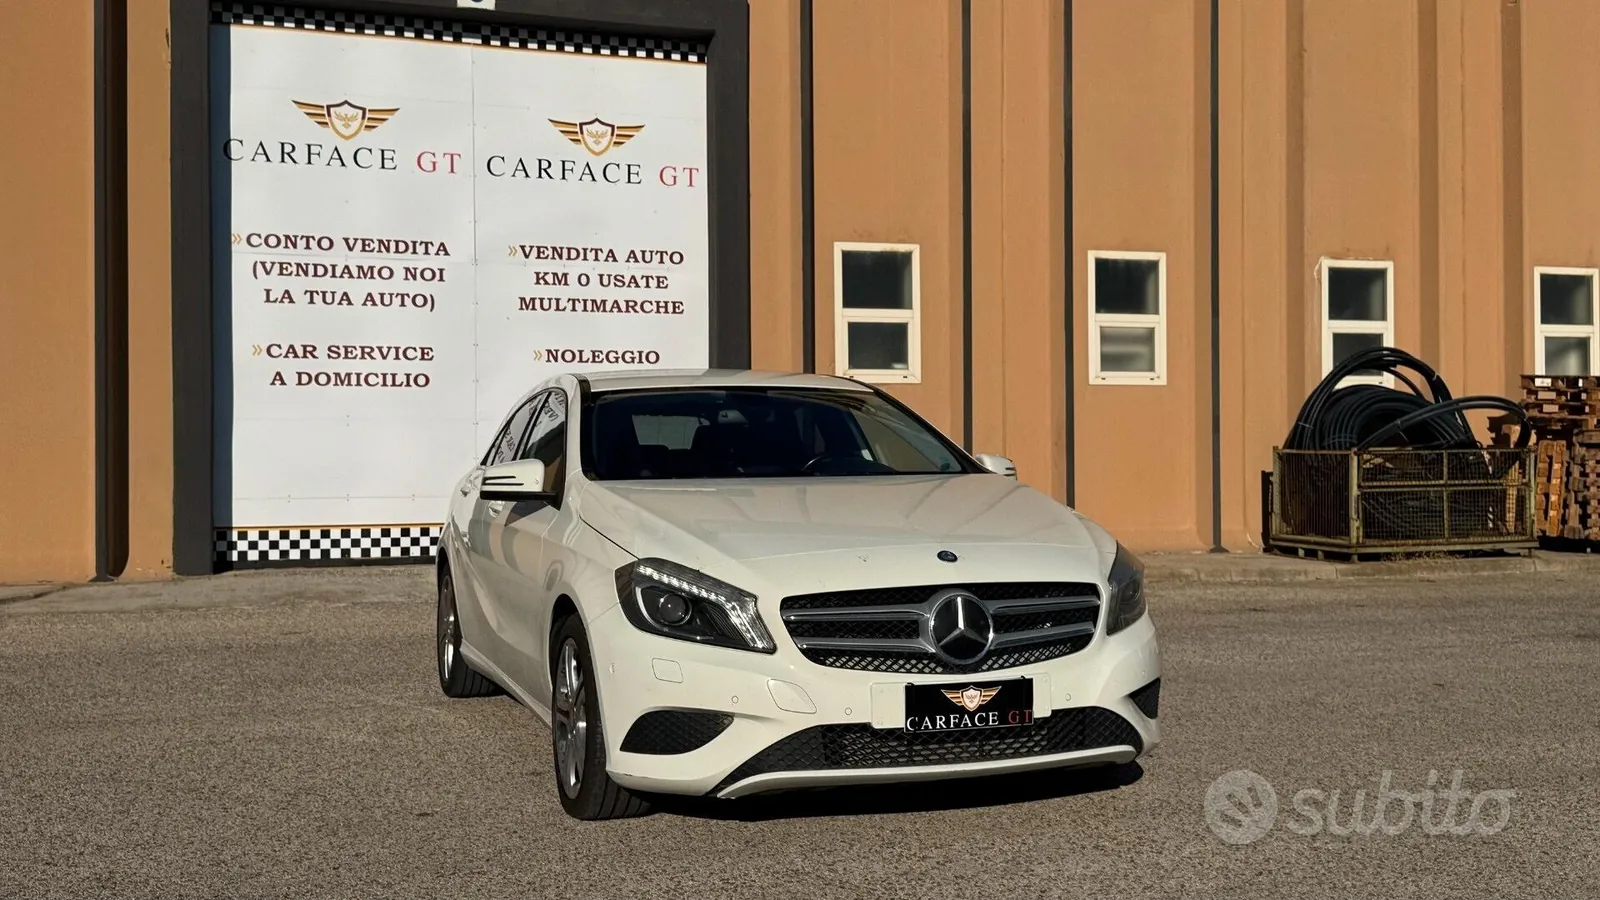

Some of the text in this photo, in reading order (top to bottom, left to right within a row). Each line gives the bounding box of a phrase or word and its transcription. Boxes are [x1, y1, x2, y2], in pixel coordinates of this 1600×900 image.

[222, 138, 462, 175] CARFACE GT
[486, 154, 700, 188] CARFACE GT
[245, 232, 451, 257] CONTO VENDITA
[519, 245, 685, 265] VENDITA AUTO
[251, 260, 446, 283] (VENDIAMO NOI
[533, 271, 570, 288] KM
[598, 273, 669, 290] USATE
[263, 288, 436, 312] LA TUA AUTO)
[518, 297, 685, 315] MULTIMARCHE
[266, 343, 434, 362] CAR SERVICE
[545, 348, 661, 365] NOLEGGIO
[270, 371, 430, 388] A DOMICILIO
[906, 709, 1032, 731] CARFACE GT
